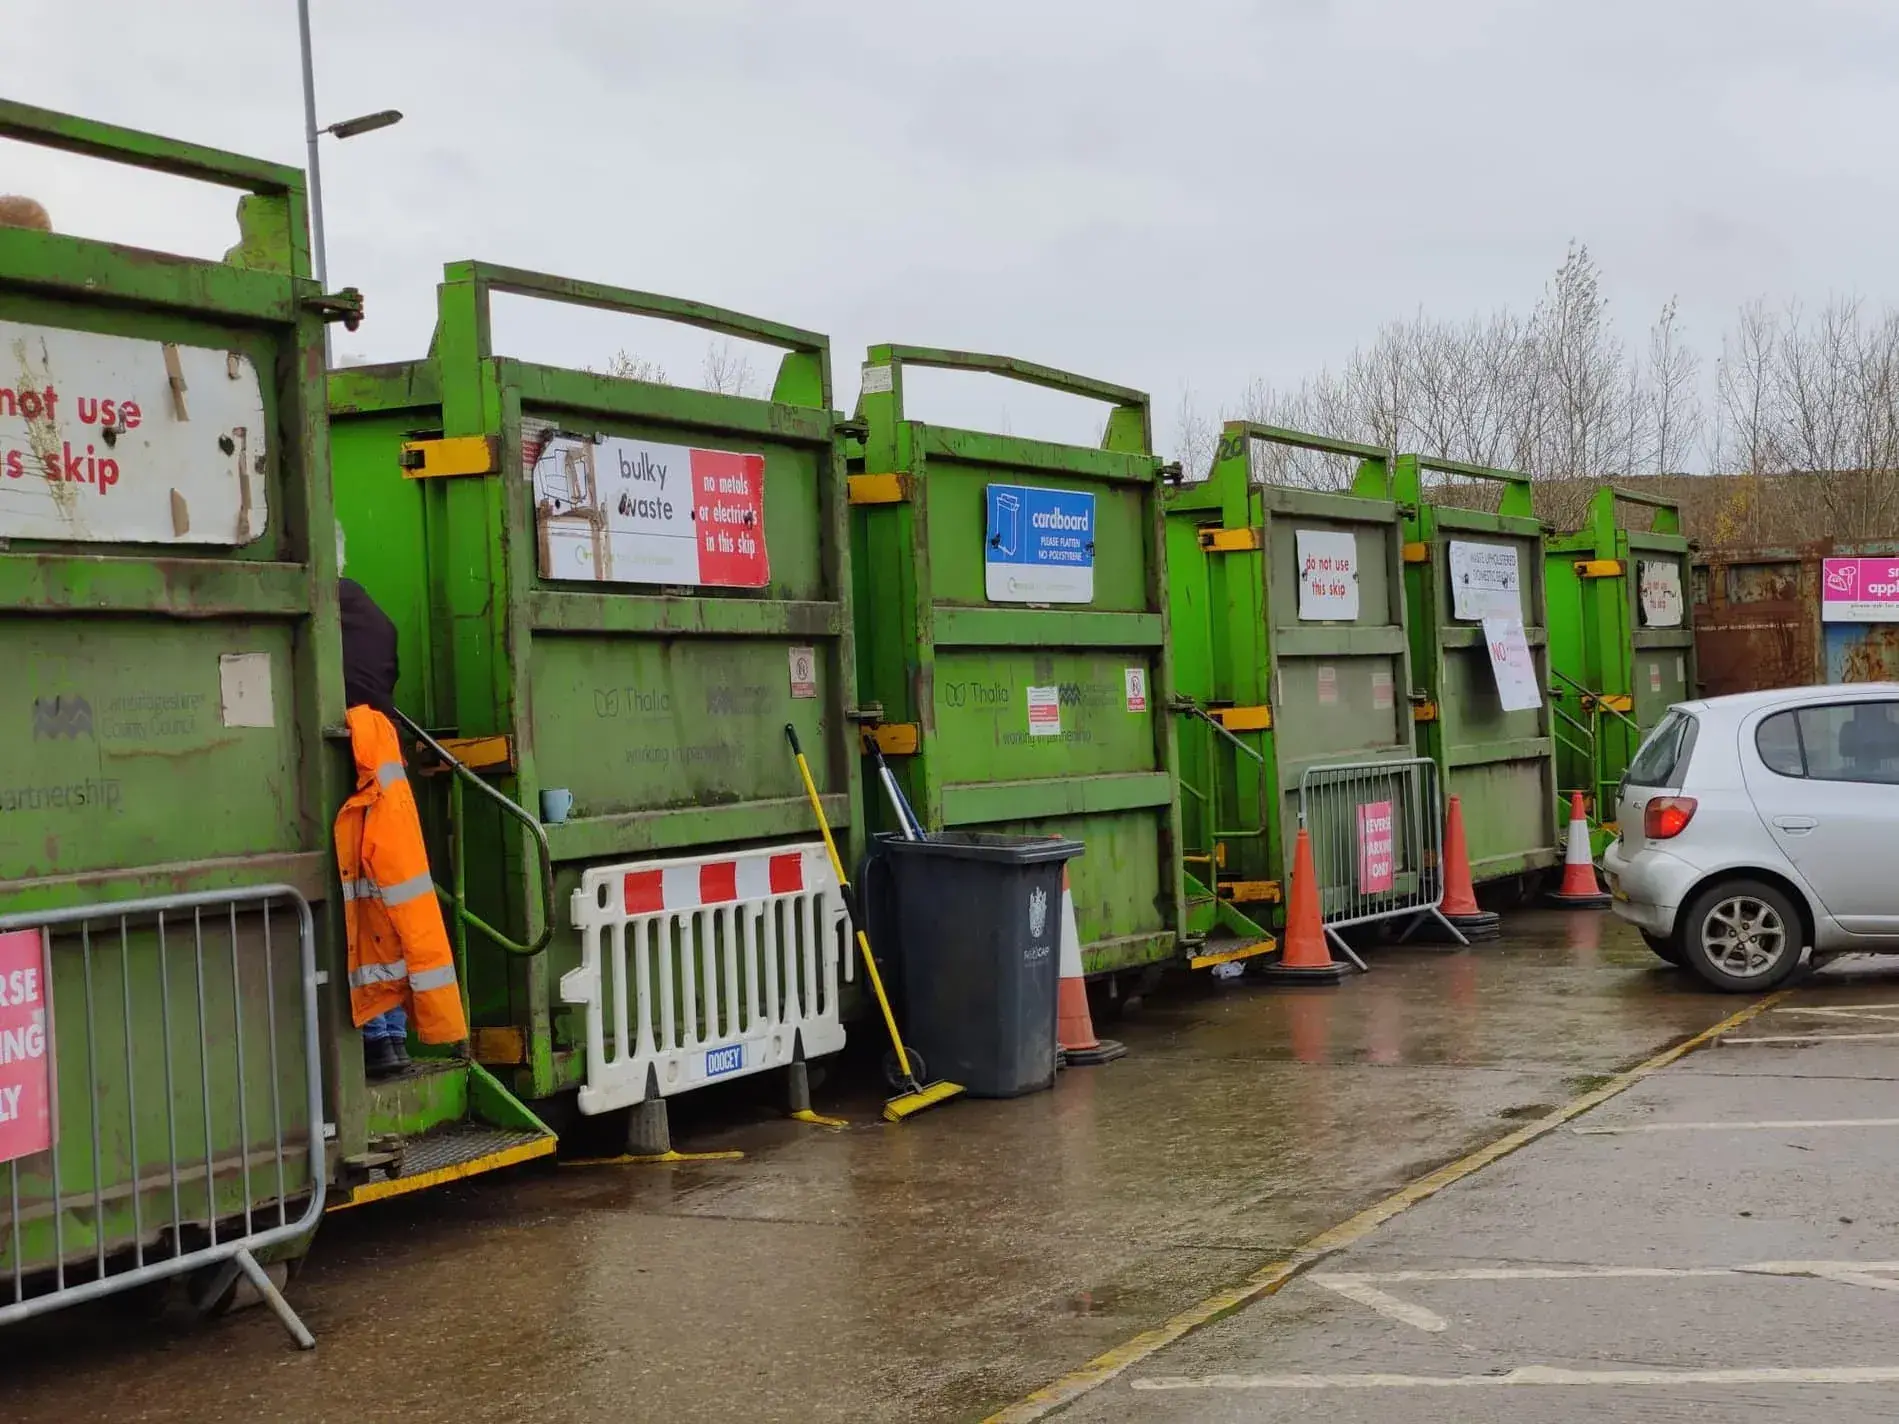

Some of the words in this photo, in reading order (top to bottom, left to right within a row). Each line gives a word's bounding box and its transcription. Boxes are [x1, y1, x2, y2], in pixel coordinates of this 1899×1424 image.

[77, 396, 142, 428] use
[44, 441, 120, 495] skip
[618, 448, 667, 491] bulky
[703, 476, 715, 492] no
[719, 472, 749, 495] metals
[699, 505, 709, 522] or
[1032, 506, 1089, 531] cardboard
[705, 530, 715, 552] in
[718, 529, 734, 553] this
[738, 530, 755, 560] skip
[1040, 535, 1060, 548] PLEASE
[1060, 536, 1081, 548] FLATTEN
[1038, 550, 1049, 560] NO
[1306, 552, 1316, 571] do
[1319, 554, 1332, 571] not
[1335, 559, 1349, 572] use
[1312, 576, 1326, 597] this
[1329, 576, 1346, 600] skip
[1491, 641, 1506, 661] NO
[624, 686, 671, 711] Thalia
[970, 683, 1009, 704] Thalia
[709, 1047, 740, 1074] DOOCEY
